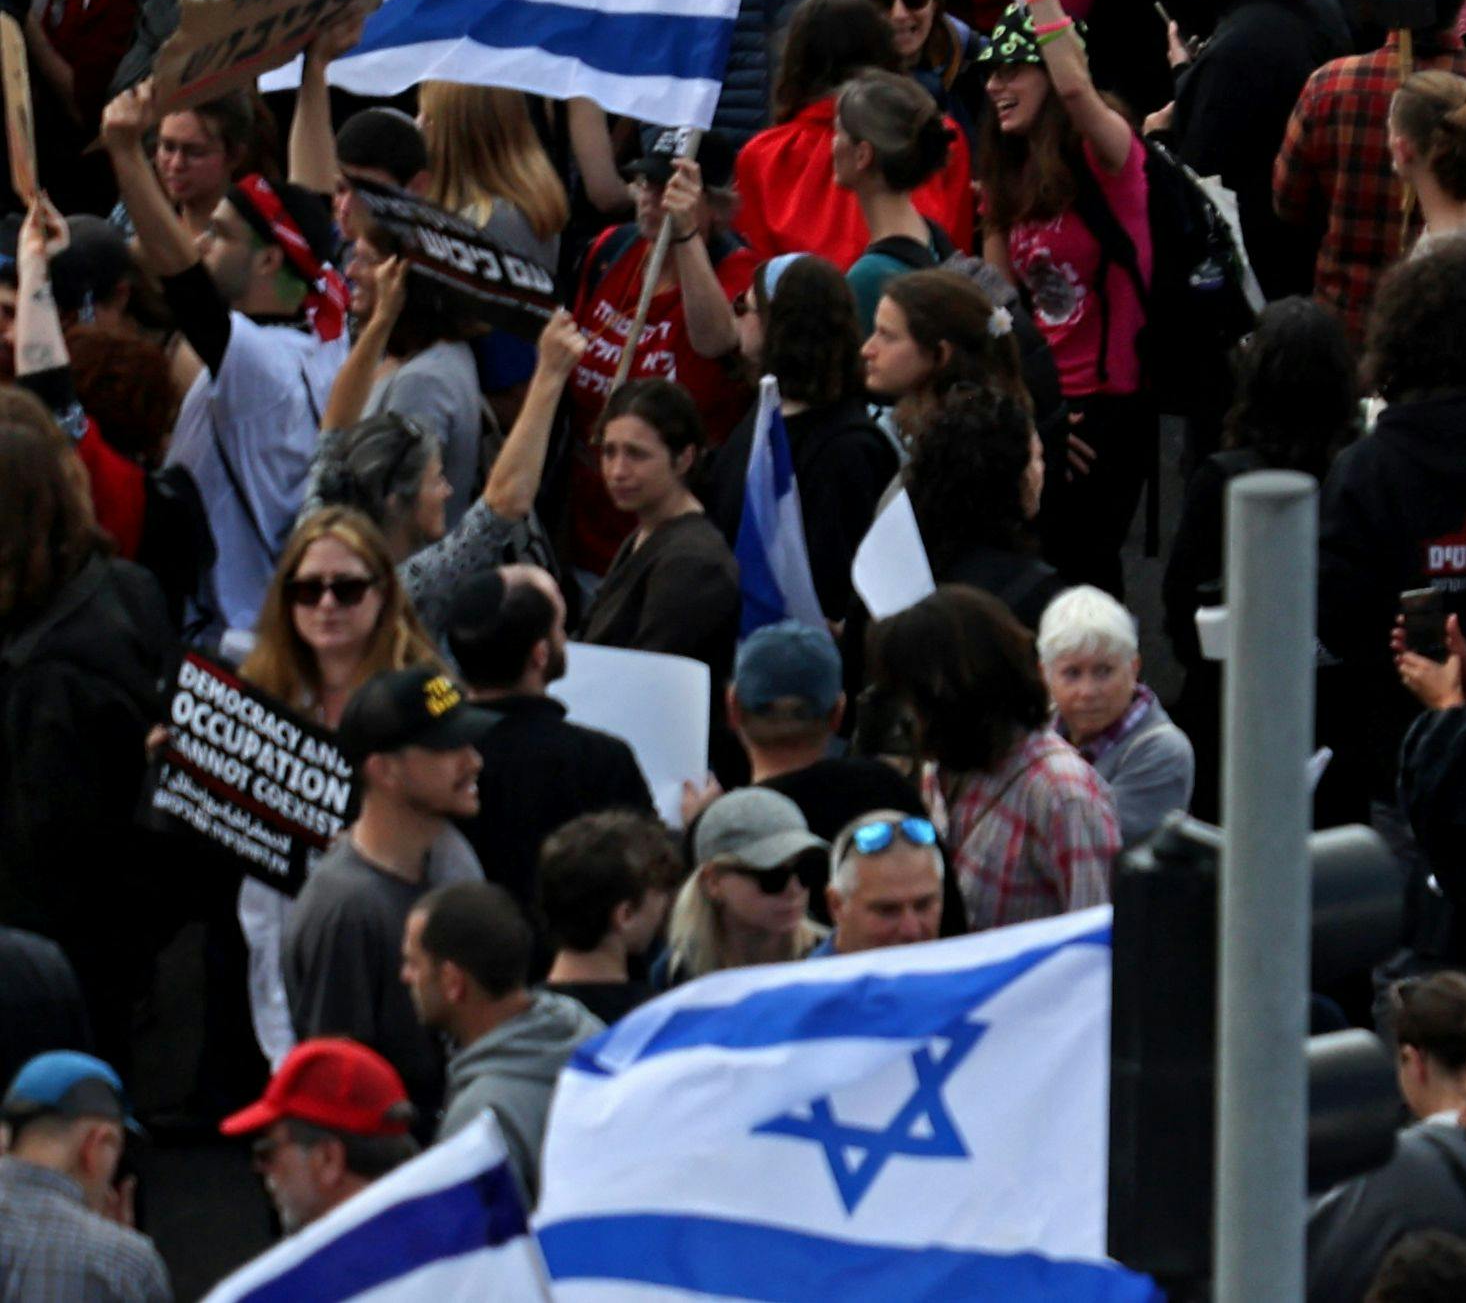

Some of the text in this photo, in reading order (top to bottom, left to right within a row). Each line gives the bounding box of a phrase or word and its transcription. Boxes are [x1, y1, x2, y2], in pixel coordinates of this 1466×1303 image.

[178, 661, 300, 749] DEMOCRACY
[170, 691, 352, 814] OCCUPATION
[251, 774, 345, 837] COEXIST
